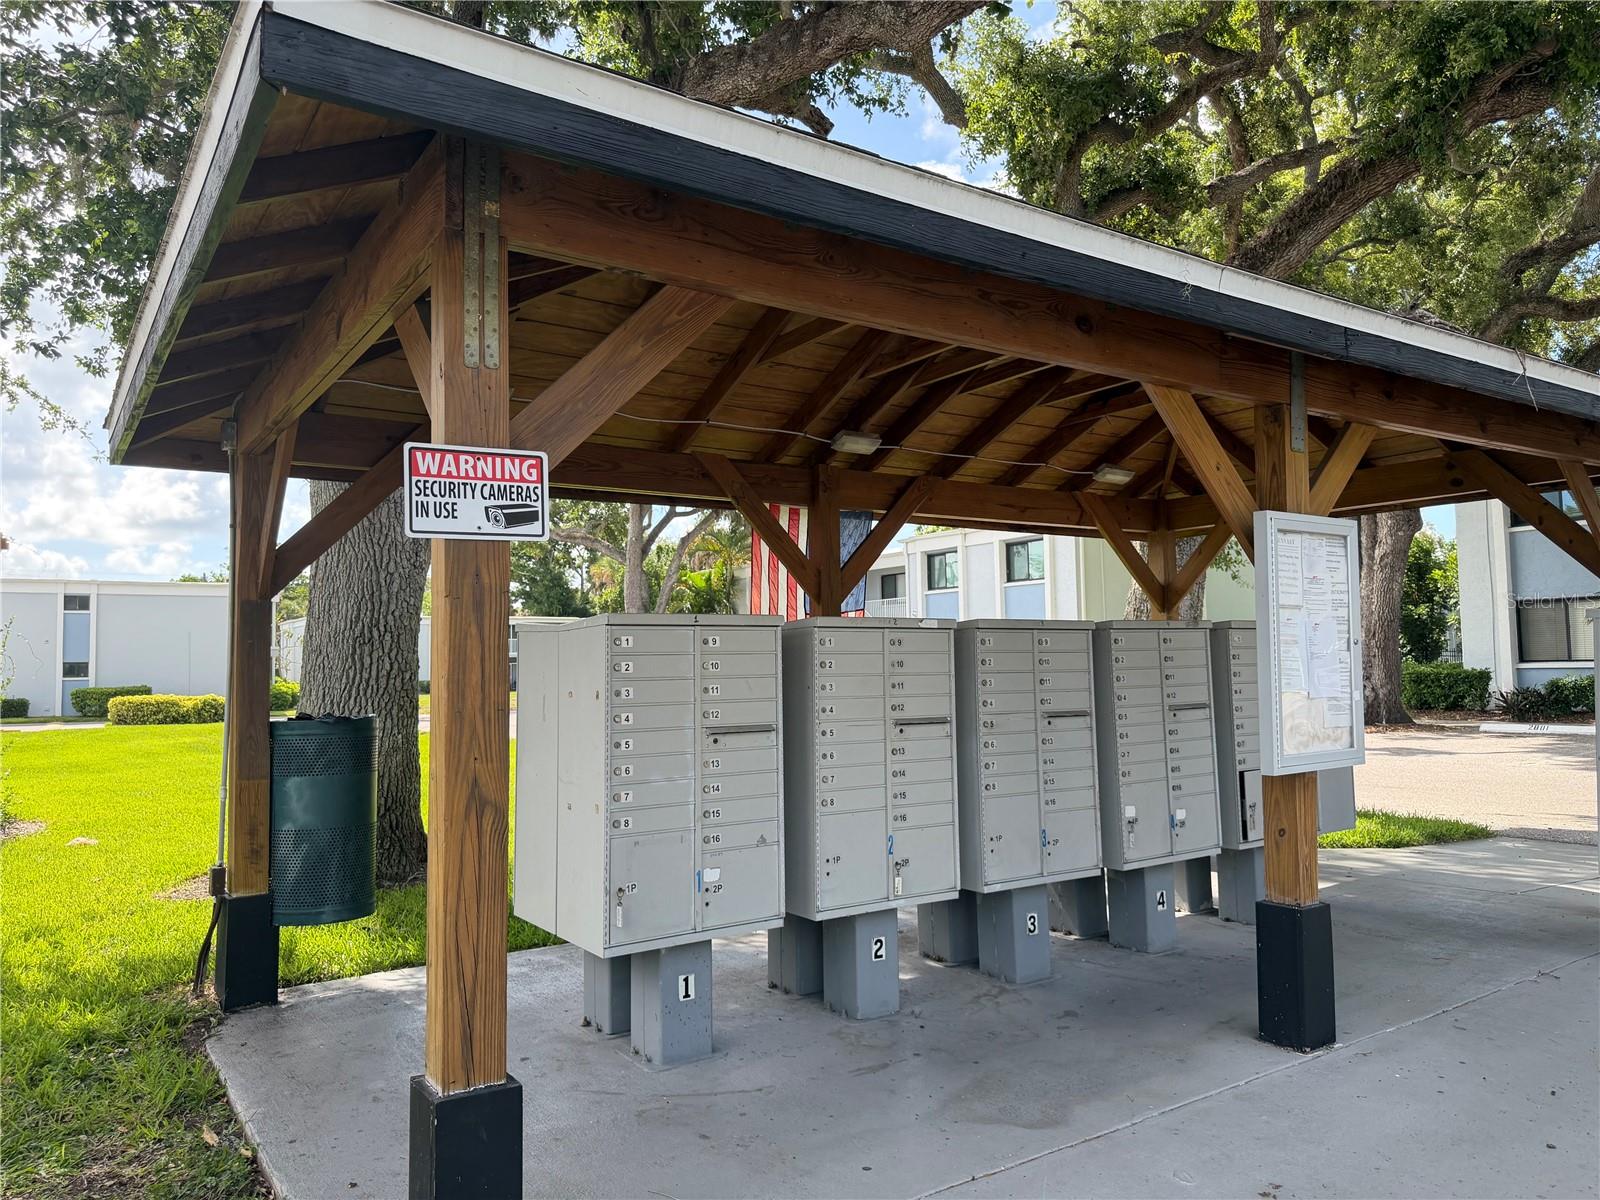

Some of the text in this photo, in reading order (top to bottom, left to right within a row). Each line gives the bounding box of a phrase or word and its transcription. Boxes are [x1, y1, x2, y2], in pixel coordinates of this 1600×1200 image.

[416, 452, 537, 481] WARNING
[415, 479, 539, 502] SECURITY CAMERAS
[415, 500, 458, 519] IN USE
[711, 638, 717, 646] 9
[624, 663, 630, 672] 2
[710, 662, 719, 670] 10
[624, 689, 630, 697] 3
[710, 686, 719, 694] 11
[624, 715, 630, 723] 4
[710, 711, 720, 719] 12
[624, 741, 630, 749] 5
[711, 760, 720, 768] 13
[624, 767, 630, 775] 6
[711, 784, 720, 793] 14
[624, 793, 630, 801] 7
[711, 810, 721, 818] 15
[623, 820, 630, 828] 8
[711, 835, 720, 843] 16
[1042, 829, 1047, 847] 3
[888, 835, 894, 855] 2
[832, 856, 841, 864] 1P
[696, 870, 701, 893] 1
[626, 883, 637, 893] 1P
[712, 884, 723, 894] 2P
[1157, 892, 1165, 908] 4
[1028, 915, 1036, 934] 3
[873, 938, 884, 959] 2
[682, 976, 691, 999] 1
